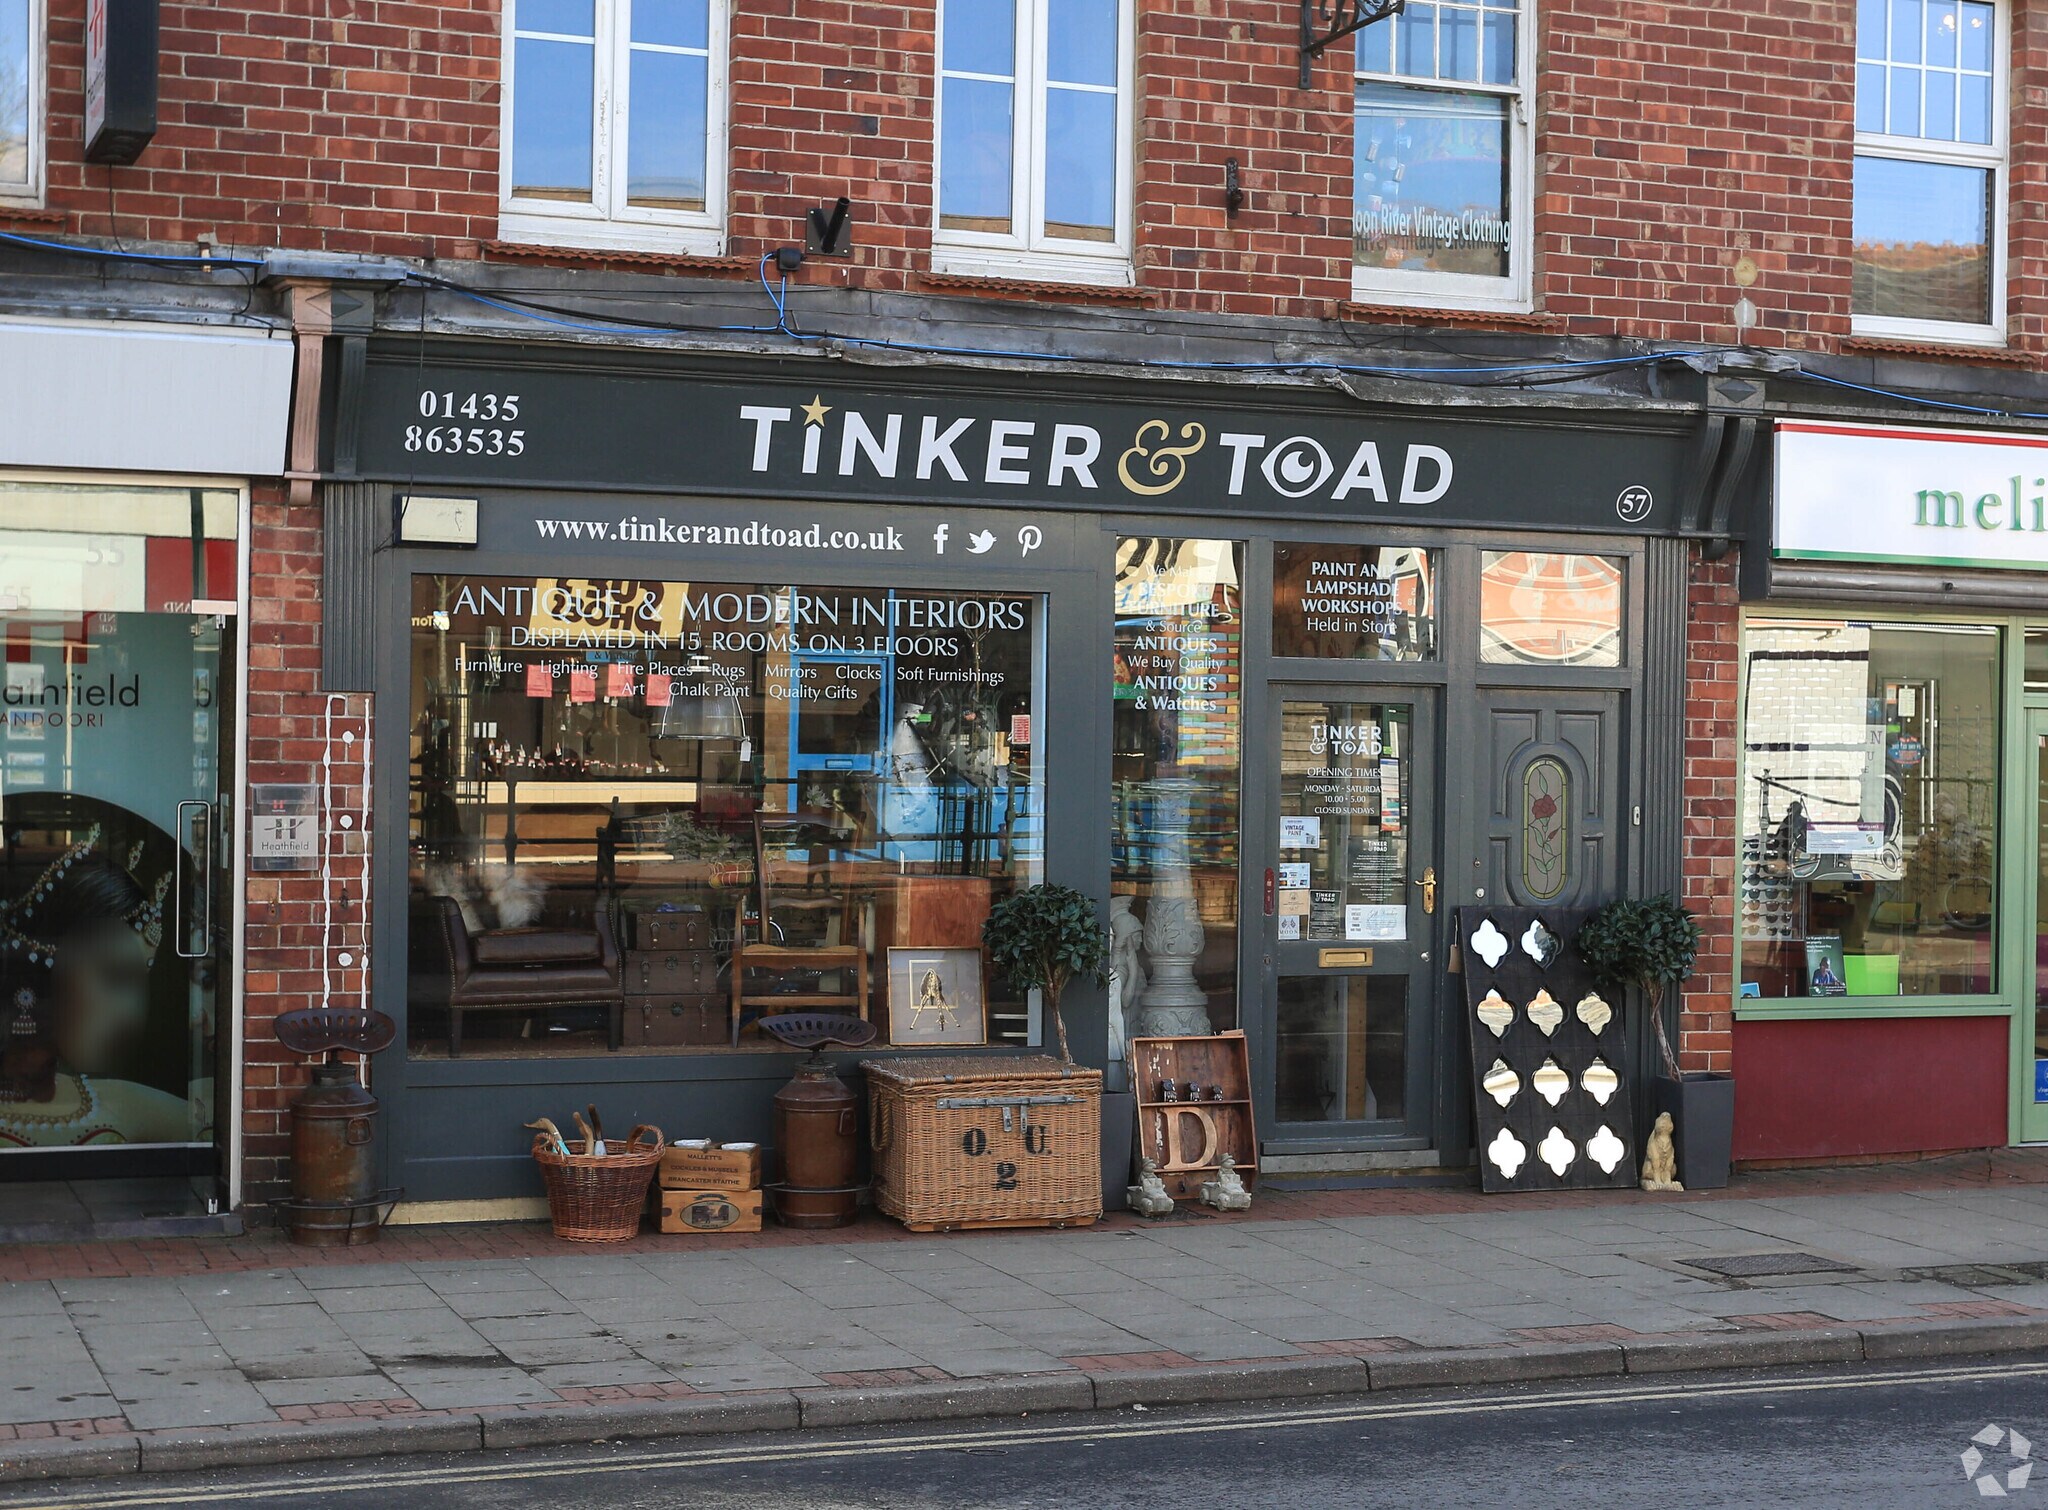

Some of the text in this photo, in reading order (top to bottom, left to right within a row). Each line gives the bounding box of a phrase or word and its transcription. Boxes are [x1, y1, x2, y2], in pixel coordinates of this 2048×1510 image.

[1352, 203, 1512, 252] oon River Vintage Clothing
[420, 390, 520, 421] 01435
[404, 425, 526, 456] 863535
[1117, 418, 1206, 496] &
[1621, 494, 1648, 514] 57
[1912, 475, 2048, 532] meli
[535, 516, 904, 551] www.tinkerandtoad.co.uk
[1311, 561, 1357, 577] PAINT
[1306, 580, 1400, 597] LAMPSHADE
[452, 585, 621, 625] ANTIQUE
[638, 591, 663, 621] &
[679, 591, 839, 627] MODERN
[851, 597, 1025, 630] INTERIORS
[1301, 598, 1403, 615] WORKSHOPS
[1145, 621, 1202, 633] & Source
[1307, 617, 1340, 632] Held
[1345, 618, 1357, 632] in
[511, 626, 959, 657] DISPLAYED IN 15 ROOMS ON 3 FLOORS
[1133, 635, 1217, 654] ANTIQUES
[454, 657, 1005, 687] Furniture Lighting Fire Places Rugs Mirrors Clocks Soft Furnishings
[1128, 655, 1223, 674] We Buy Quality
[621, 681, 858, 703] Art Chalk Paint Quality Gifts
[1133, 675, 1217, 693] ANTIQUES
[1134, 696, 1217, 711] & Watches
[1307, 767, 1353, 777] OPENING
[1304, 784, 1340, 793] MONDAY
[1324, 795, 1344, 803] 10.00
[1350, 795, 1366, 803] 5.00
[1342, 807, 1375, 815] SUNDAYS
[261, 841, 309, 851] Heathfield
[1160, 1106, 1218, 1170] D
[668, 1176, 712, 1184] BRANCASTER
[996, 1162, 1020, 1191] 2
